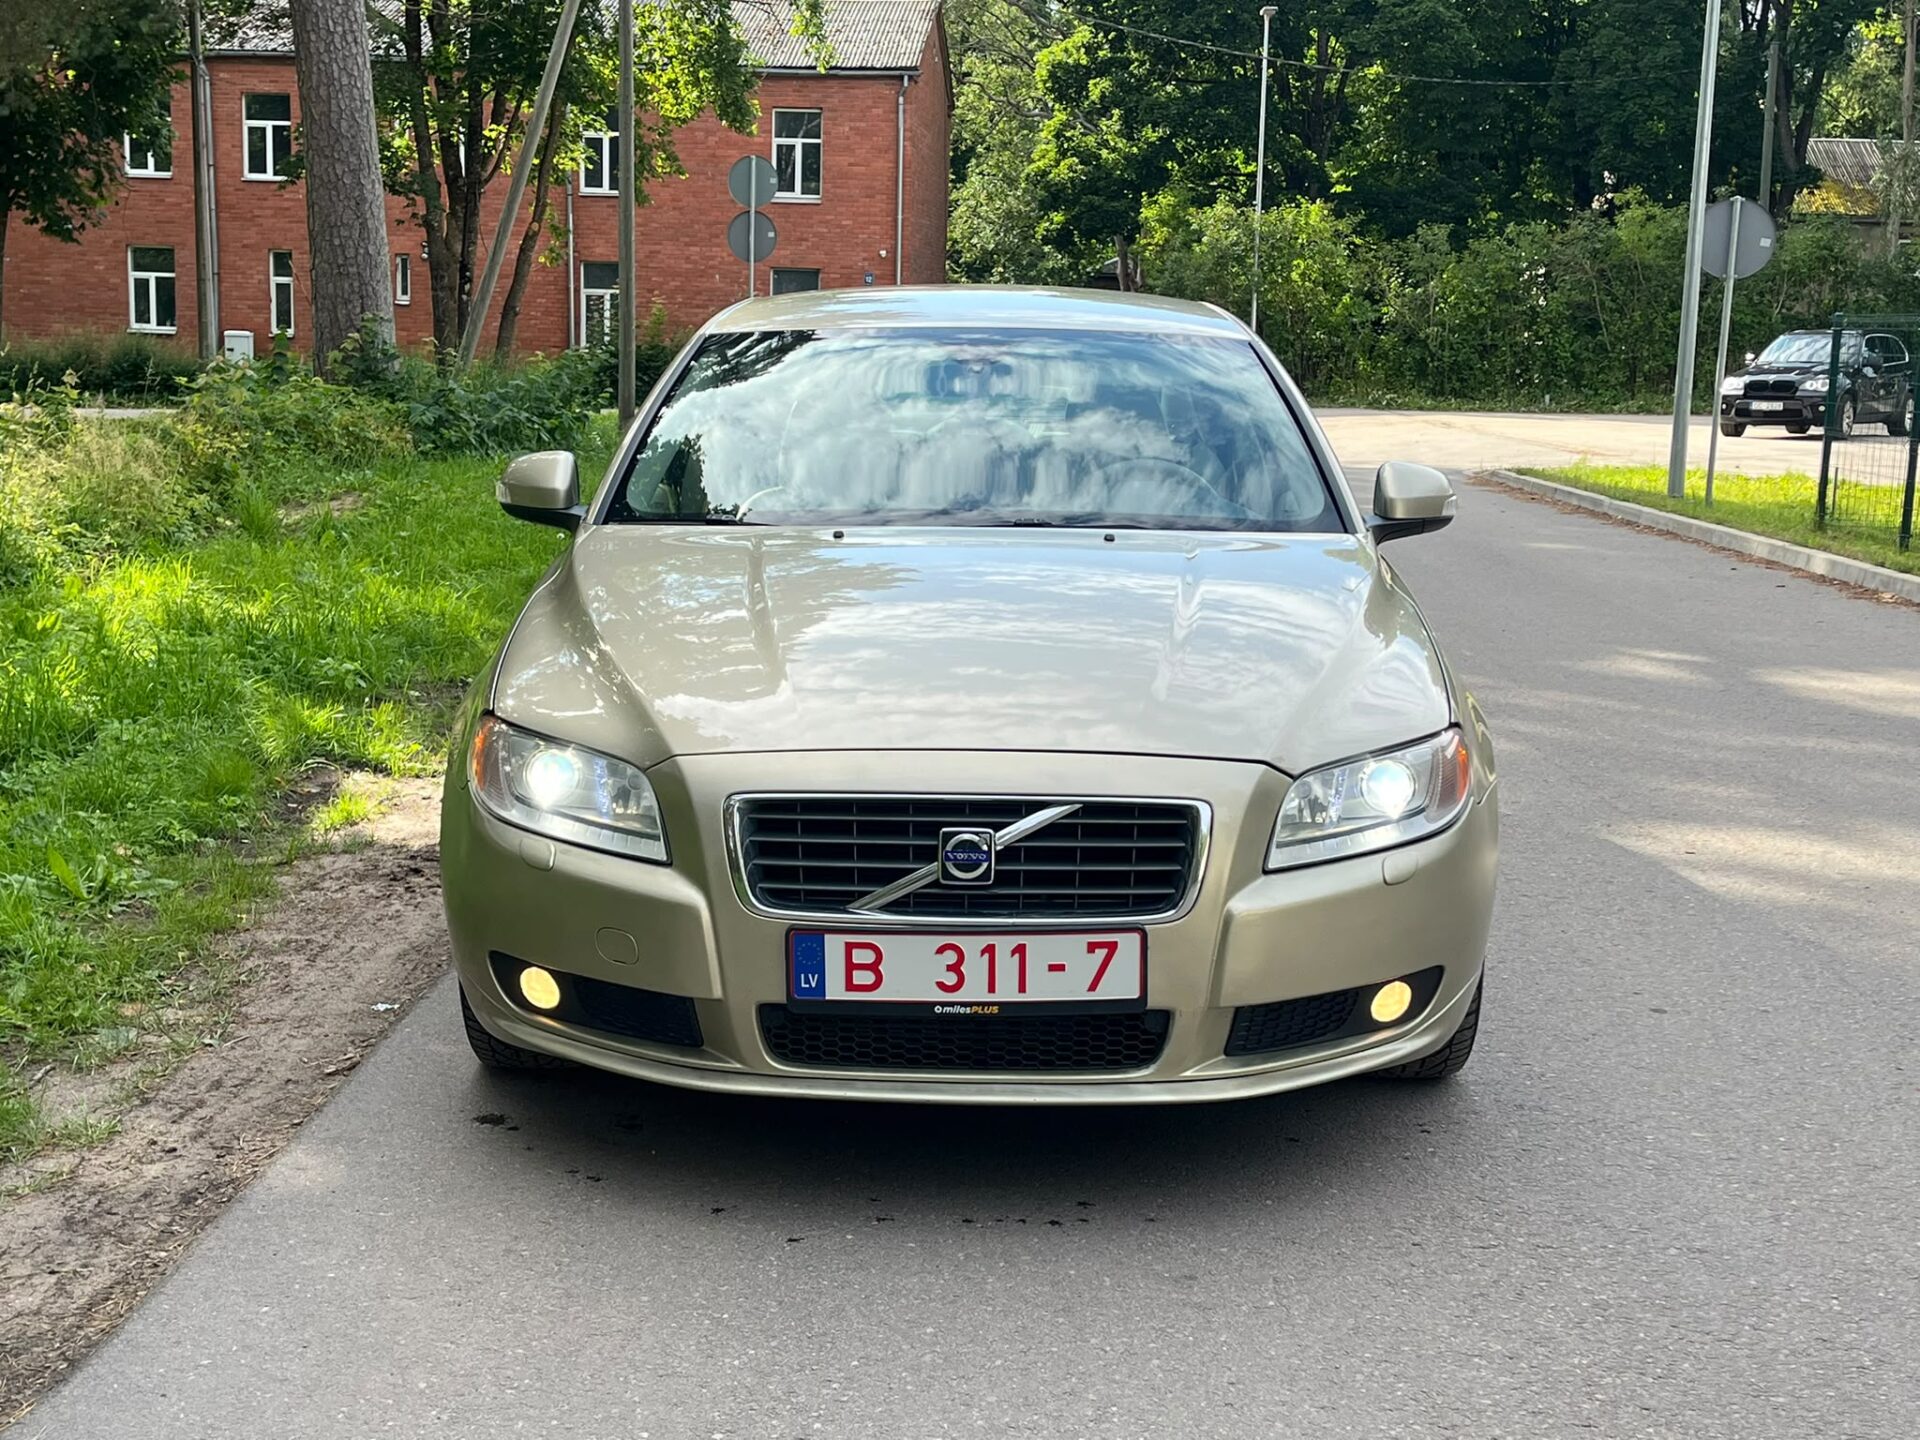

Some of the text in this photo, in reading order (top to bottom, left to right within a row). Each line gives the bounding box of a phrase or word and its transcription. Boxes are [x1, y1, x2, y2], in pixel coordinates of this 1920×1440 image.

[946, 852, 987, 860] VOLVO
[844, 941, 884, 992] B
[800, 973, 818, 988] LV
